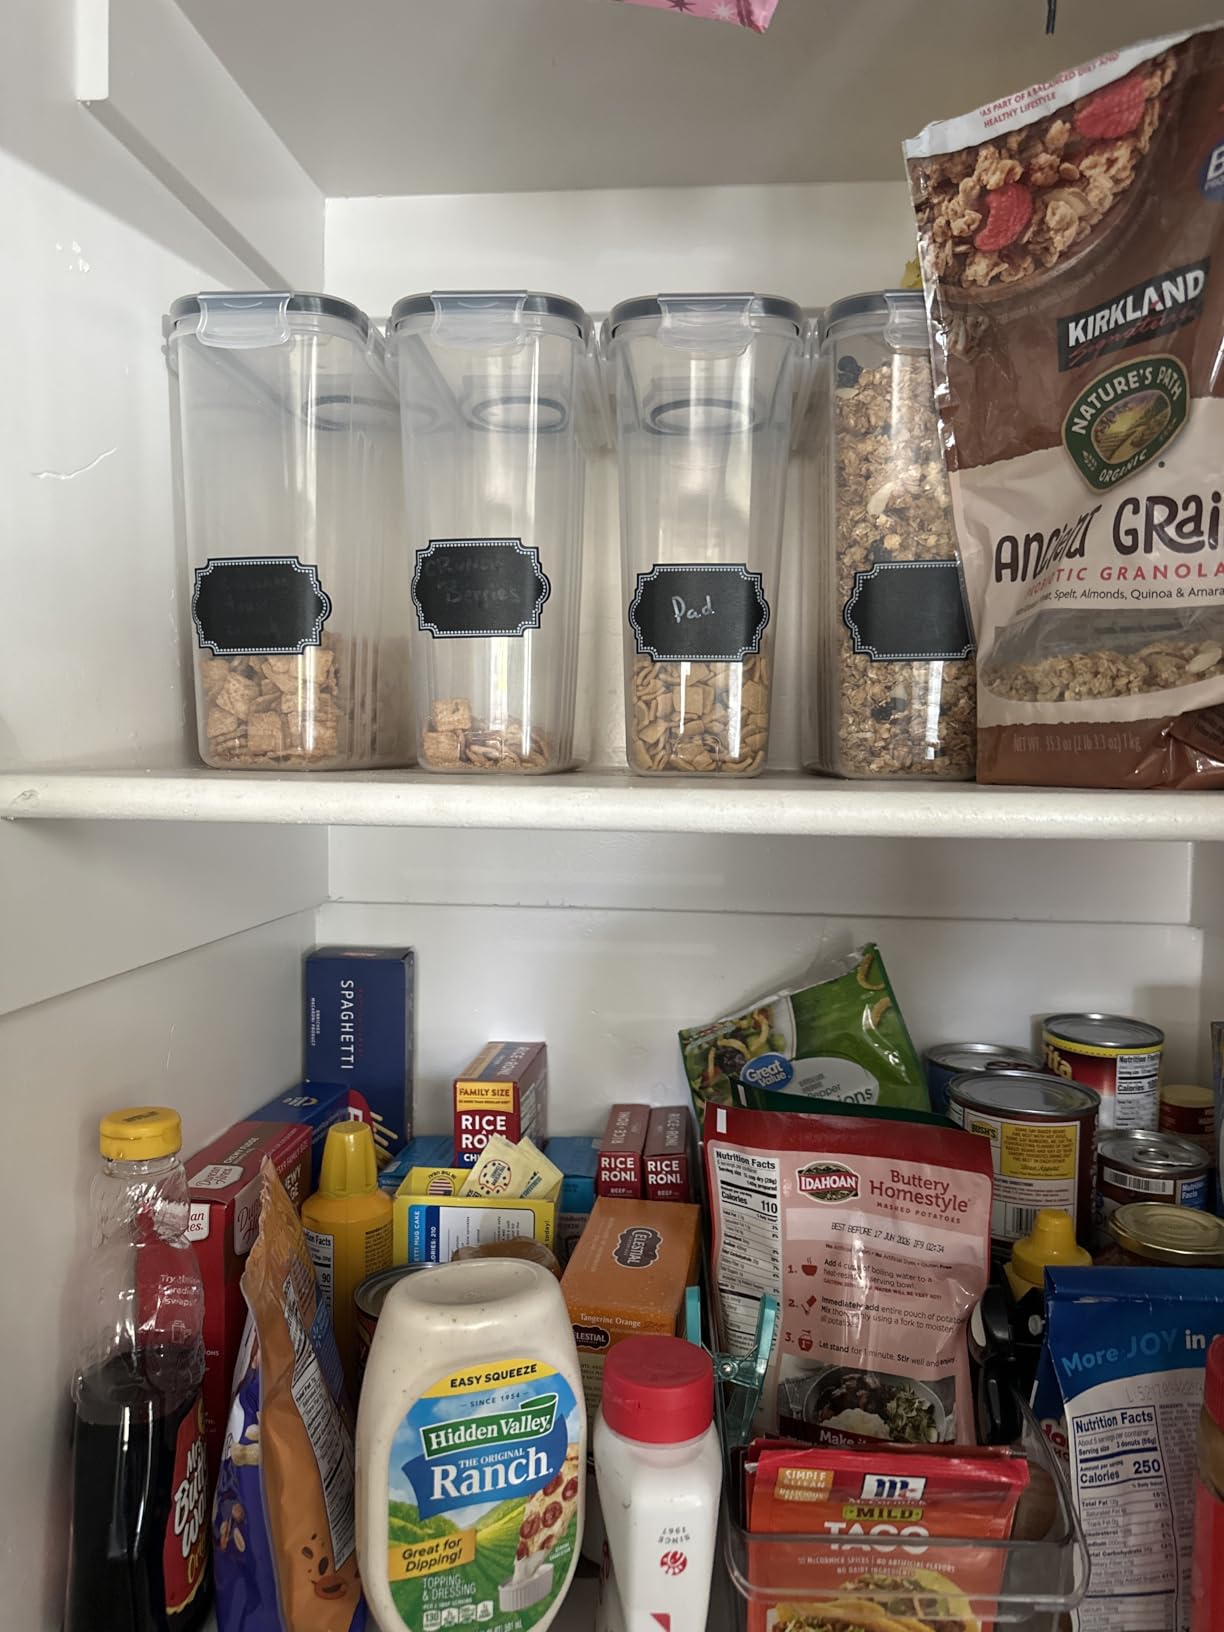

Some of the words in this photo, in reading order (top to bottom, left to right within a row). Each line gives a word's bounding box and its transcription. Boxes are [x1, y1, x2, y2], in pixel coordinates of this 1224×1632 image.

[984, 107, 1019, 128] HEALTHY
[1020, 92, 1057, 113] LIFESTYLE
[993, 98, 1012, 113] PART
[1014, 92, 1026, 103] OF
[1067, 269, 1206, 347] KIRKLAND
[1072, 367, 1153, 434] NATURE'S
[1156, 366, 1183, 400] PATH
[1099, 449, 1148, 482] ORGANIC
[1053, 589, 1078, 601] Spelt,
[1082, 588, 1127, 601] Almonds,
[1131, 588, 1173, 601] Quinoa
[1175, 589, 1185, 598] &
[671, 594, 716, 624] Dad
[340, 980, 354, 1069] SPAGHETTI
[746, 1060, 784, 1082] Great
[758, 1071, 787, 1087] Value
[459, 1088, 489, 1097] FAMILY
[491, 1088, 510, 1097] SIZE
[461, 1115, 507, 1130] RICE
[971, 1123, 996, 1138] BUSH'S
[601, 1157, 635, 1168] RICE
[647, 1160, 680, 1172] RICE
[716, 1150, 750, 1164] Nutrition
[751, 1158, 776, 1170] Facts
[800, 1175, 857, 1191] IDAHOAN
[889, 1169, 950, 1195] Buttery
[721, 1191, 748, 1205] Calories
[761, 1200, 778, 1214] 110
[869, 1180, 969, 1213] Homestyle
[876, 1201, 911, 1214] MASHED
[915, 1209, 961, 1224] POTATOES
[315, 1235, 331, 1247] Facts
[831, 1222, 846, 1232] BEST
[847, 1224, 872, 1237] BEFORE
[874, 1230, 882, 1239] 17
[883, 1232, 896, 1242] JUN
[627, 1229, 653, 1264] CELESTIAL
[160, 1274, 176, 1284] Try
[322, 1272, 331, 1283] 90
[787, 1264, 798, 1274] 1.
[824, 1258, 837, 1268] Add
[871, 1265, 894, 1279] boiling
[895, 1270, 916, 1280] water
[918, 1273, 926, 1282] to
[870, 1276, 895, 1289] serving
[788, 1299, 799, 1308] 2.
[822, 1296, 864, 1311] Immediately
[865, 1303, 880, 1313] add
[881, 1306, 903, 1316] entire
[903, 1308, 927, 1321] pouch
[927, 1311, 936, 1320] of
[580, 1312, 613, 1325] Tangerine
[615, 1316, 641, 1328] Orange
[821, 1305, 832, 1315] Mix
[872, 1314, 893, 1325] using
[900, 1317, 915, 1328] fork
[916, 1321, 925, 1329] to
[925, 1322, 954, 1334] moisten
[785, 1332, 795, 1343] 3.
[819, 1339, 829, 1349] Let
[829, 1342, 850, 1353] stand
[851, 1346, 862, 1354] for
[896, 1354, 910, 1363] Stir
[911, 1357, 925, 1366] well
[925, 1359, 940, 1368] and
[1061, 1346, 1118, 1377] More
[1126, 1328, 1178, 1359] JOY
[1184, 1329, 1206, 1350] in
[450, 1375, 482, 1388] EASY
[485, 1363, 537, 1383] SQUEEZE
[470, 1398, 496, 1408] SINCE
[501, 1392, 520, 1402] 1954
[429, 1423, 499, 1450] Hidden
[500, 1414, 551, 1437] Valley
[1075, 1415, 1118, 1434] Nutrition
[1120, 1410, 1153, 1425] Facts
[819, 1430, 854, 1445] Make
[1124, 1428, 1150, 1439] container
[458, 1457, 479, 1468] THE
[480, 1447, 525, 1464] ORIGINAL
[1078, 1446, 1099, 1456] Serving
[1100, 1445, 1110, 1453] size
[430, 1446, 553, 1500] Ranch
[1080, 1470, 1120, 1484] Calories
[1133, 1459, 1161, 1475] 250
[856, 1507, 914, 1519] MILD
[1082, 1500, 1097, 1508] Total
[658, 1533, 691, 1545] SINCE
[662, 1526, 687, 1535] 1967
[824, 1521, 930, 1555] TACO
[402, 1542, 440, 1561] Great
[443, 1537, 462, 1551] for
[405, 1549, 463, 1573] Dipping!
[888, 1558, 925, 1569] ARTIFICIAL
[422, 1574, 461, 1589] TOPPING
[422, 1592, 429, 1601] &
[431, 1584, 477, 1600] DRESSING
